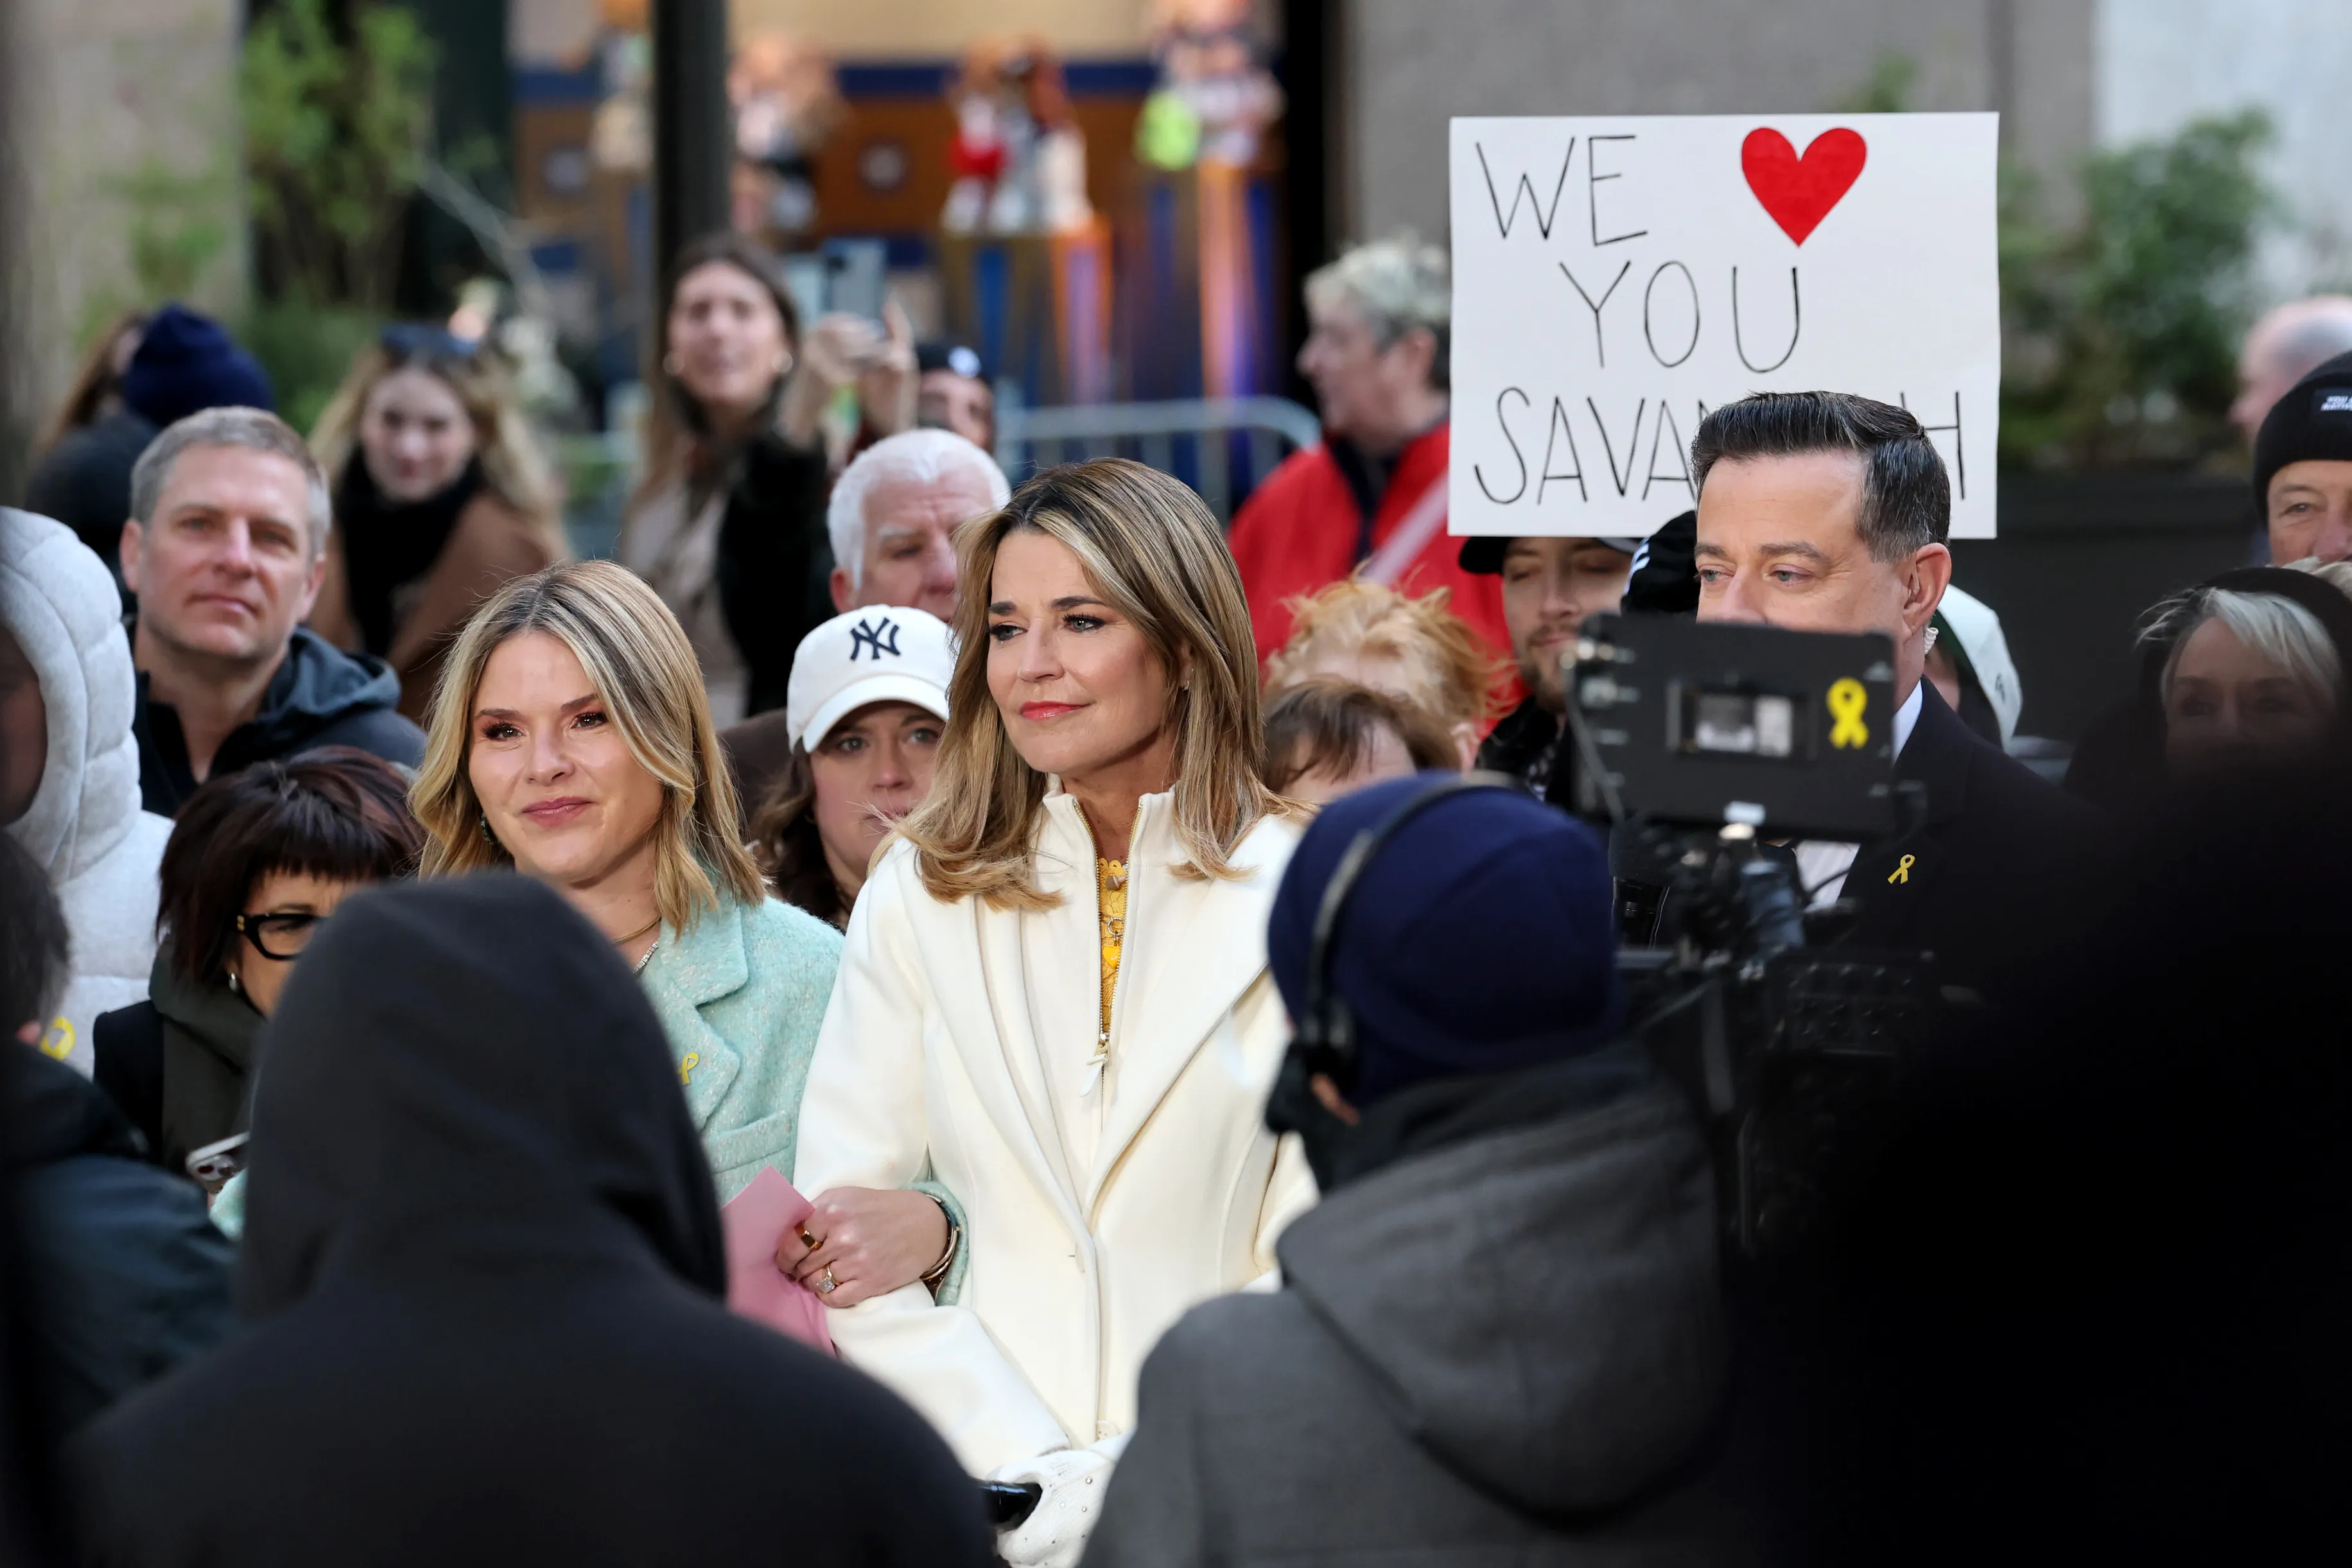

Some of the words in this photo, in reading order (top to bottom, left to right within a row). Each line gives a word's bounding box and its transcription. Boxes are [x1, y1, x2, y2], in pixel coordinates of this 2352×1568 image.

[1476, 135, 1648, 247] WE
[1559, 260, 1800, 373] YOU
[1474, 387, 1965, 505] SAVAH
[849, 617, 901, 661] NY
